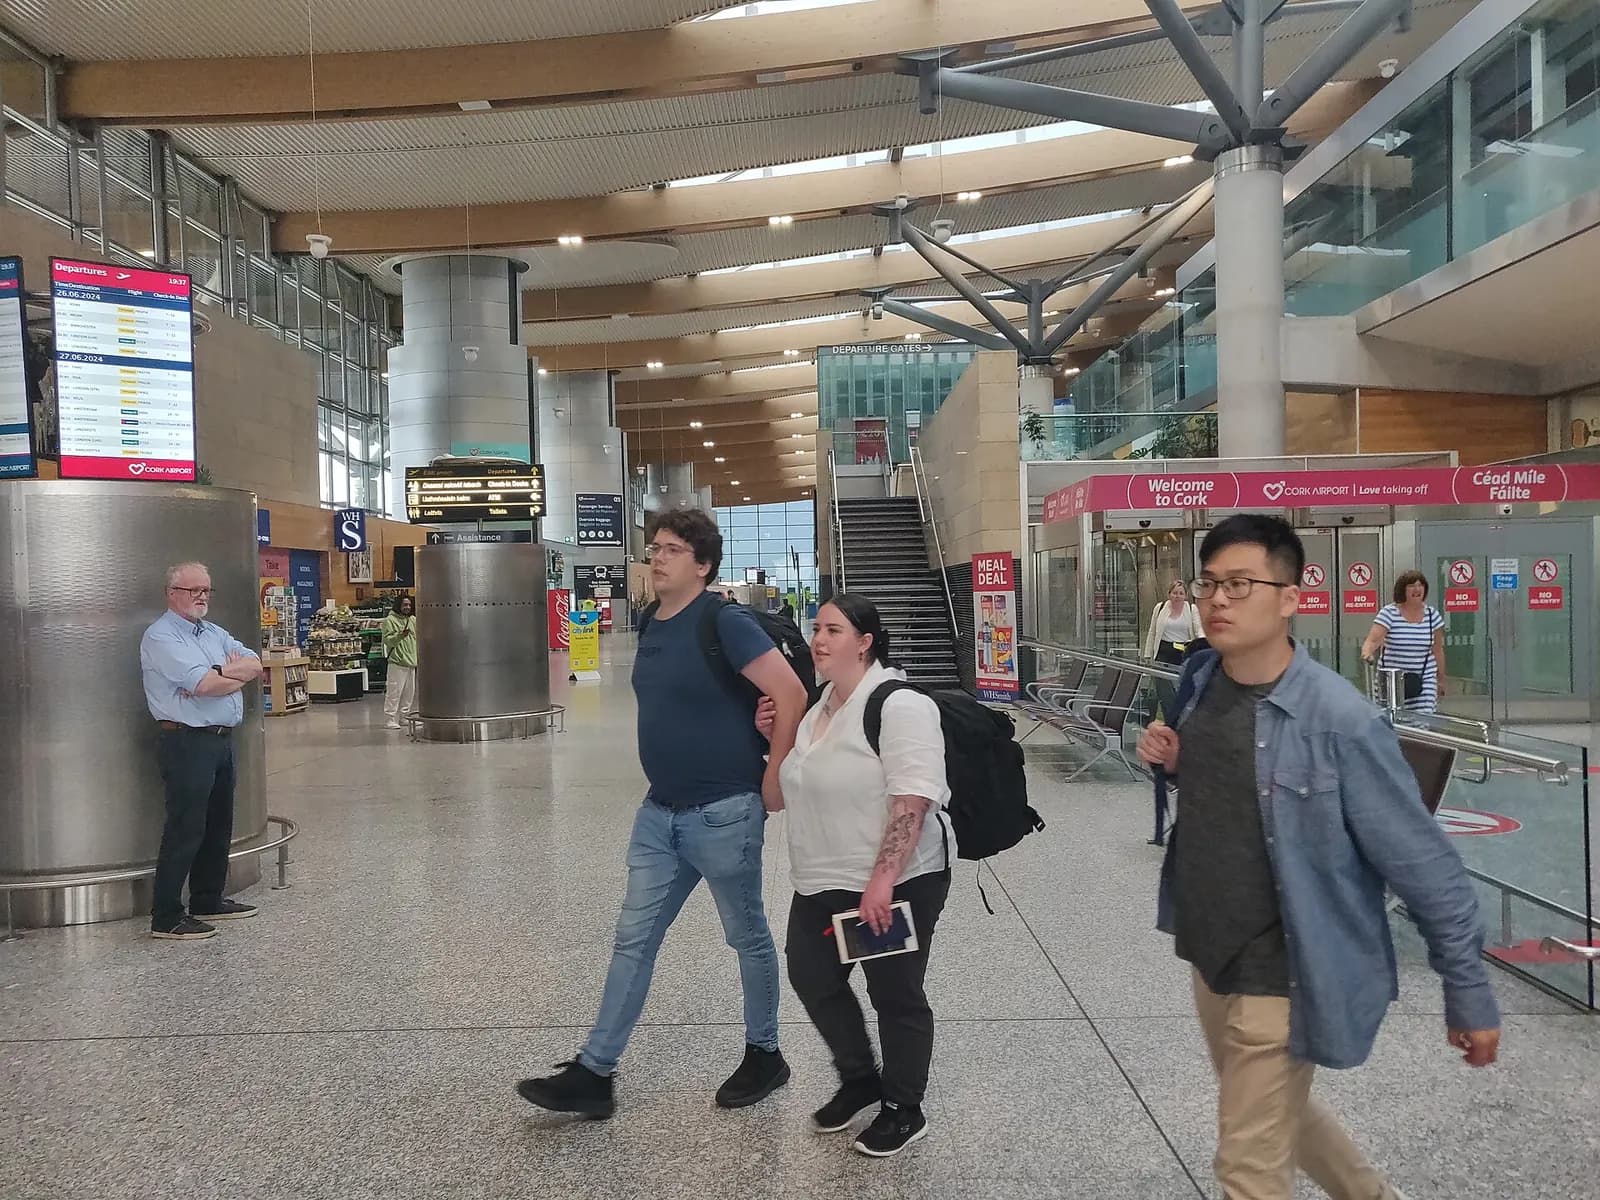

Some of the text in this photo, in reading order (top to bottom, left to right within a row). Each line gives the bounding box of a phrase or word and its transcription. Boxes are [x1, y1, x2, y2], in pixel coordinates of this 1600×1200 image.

[55, 263, 107, 276] Departures
[68, 283, 101, 291] Destination
[168, 278, 187, 286] 19:37
[57, 289, 101, 300] 26.06.2024
[832, 345, 888, 354] DEPARTURE
[59, 353, 104, 362] 27.06.2024
[145, 466, 192, 475] CORK AIRPORT
[1473, 468, 1546, 486] Céad Míle
[1148, 478, 1214, 493] Welcome
[1284, 486, 1349, 496] CORK AIRPORT
[1359, 484, 1430, 497] Love taking off
[1489, 484, 1530, 500] Fáilte
[1155, 493, 1208, 507] to Cork
[341, 512, 360, 521] WH
[341, 521, 362, 550] S
[457, 534, 501, 542] Assistance
[978, 559, 1008, 572] MEAL
[978, 572, 1008, 585] DEAL
[983, 690, 1012, 700] WHSmith
